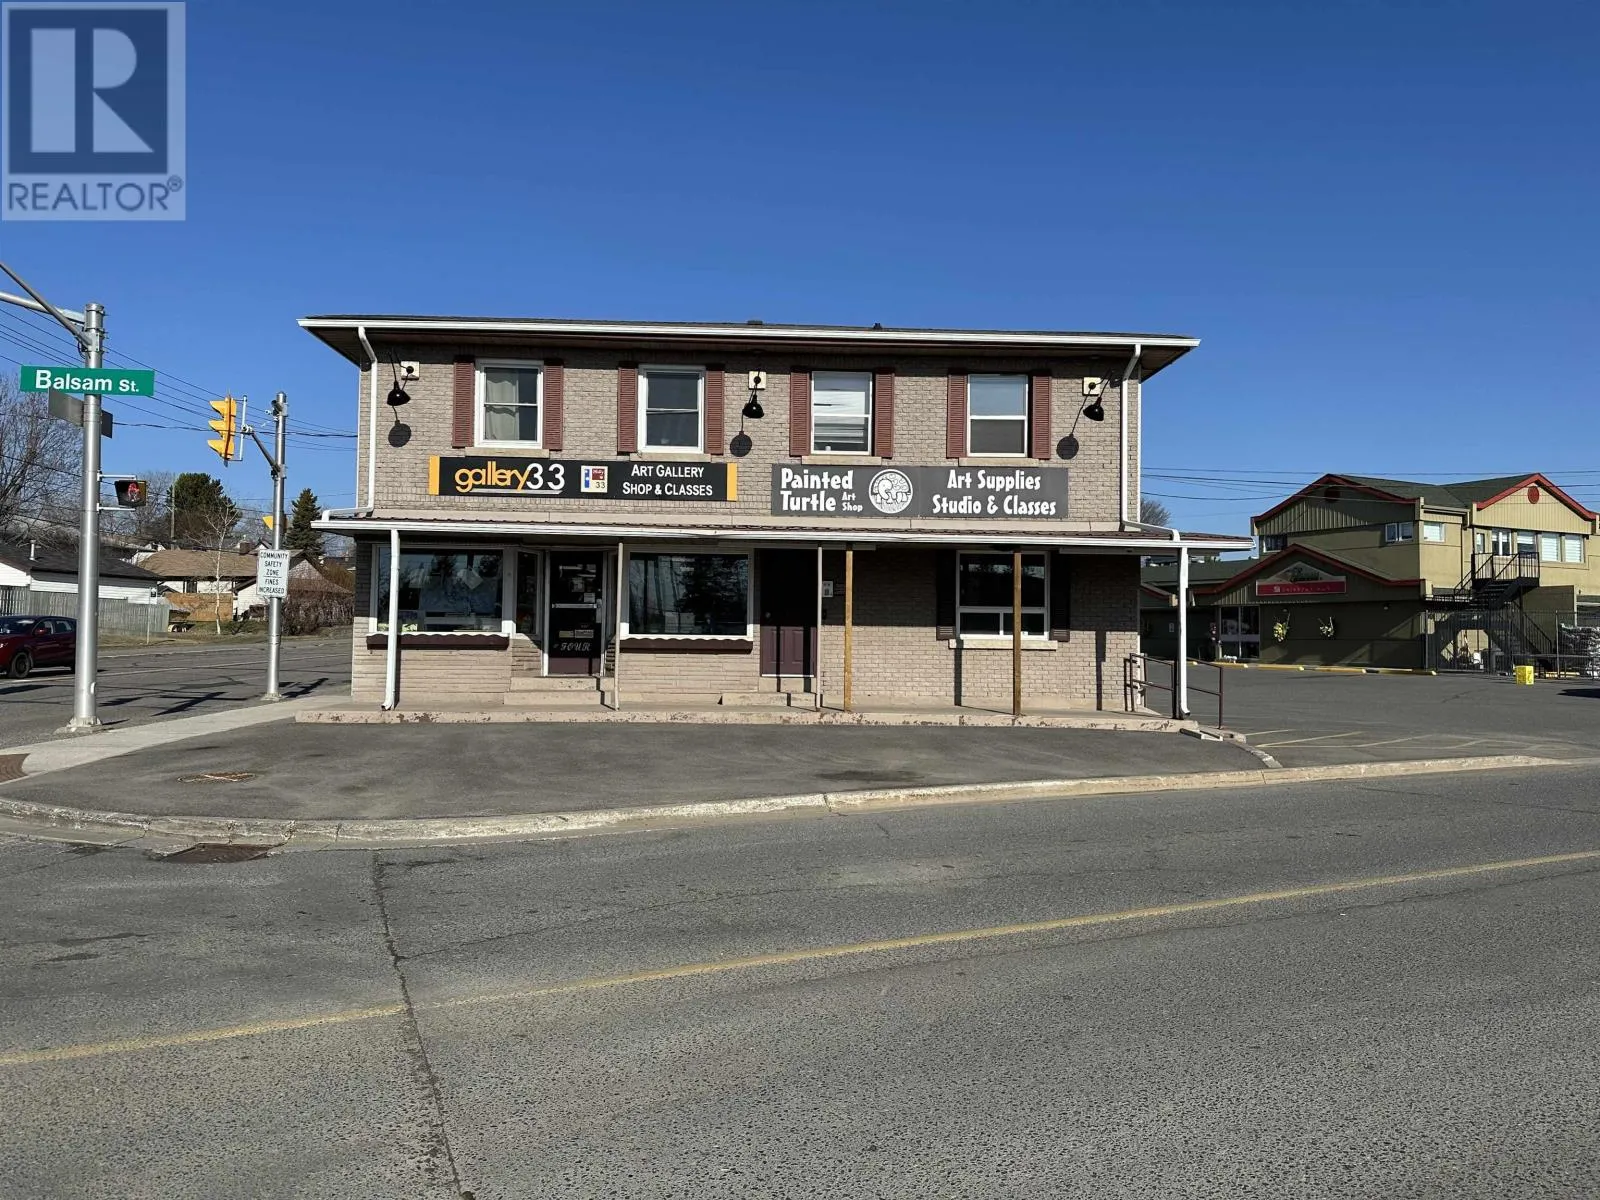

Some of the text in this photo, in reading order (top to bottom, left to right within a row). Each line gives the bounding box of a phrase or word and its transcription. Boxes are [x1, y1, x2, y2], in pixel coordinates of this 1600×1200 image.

[35, 369, 140, 393] Balsam St.
[631, 464, 704, 478] ART GALLERY
[595, 481, 605, 489] 33
[781, 467, 854, 490] Painted
[946, 469, 1042, 492] Art Supplies
[622, 481, 713, 496] SHOP & CLASSES
[780, 490, 837, 511] Turtle
[841, 492, 856, 501] Art
[842, 502, 863, 513] Shop
[932, 494, 1057, 515] Studio & Classes
[265, 578, 279, 586] FINES
[259, 586, 285, 594] INCREASED
